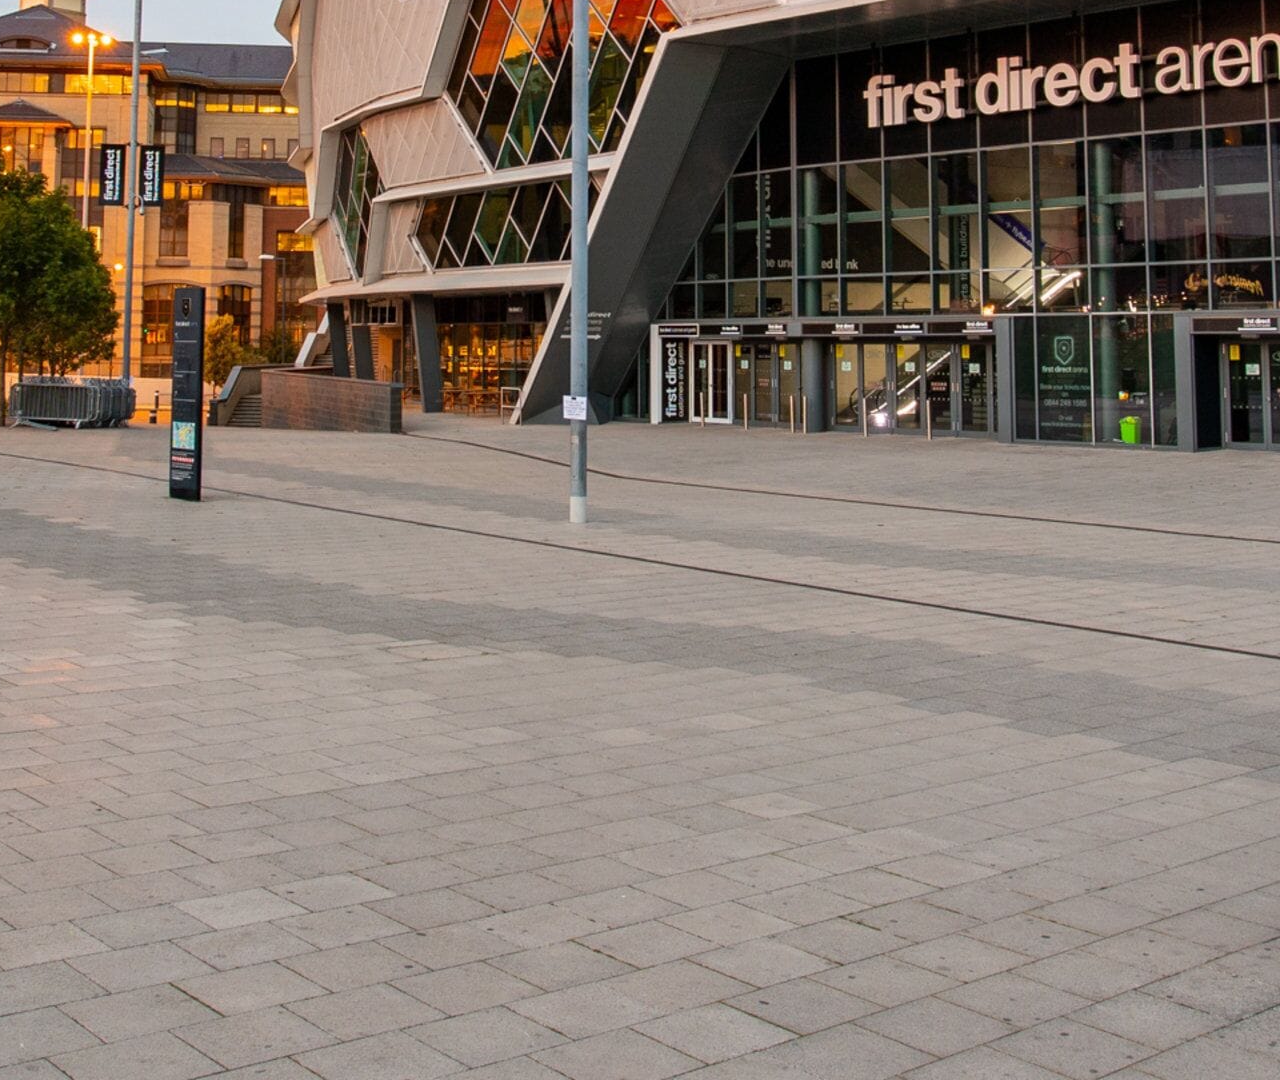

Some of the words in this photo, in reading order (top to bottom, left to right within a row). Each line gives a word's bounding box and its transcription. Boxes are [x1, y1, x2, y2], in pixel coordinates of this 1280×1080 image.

[863, 67, 966, 128] first
[975, 42, 1142, 116] direct
[104, 149, 115, 179] direct
[144, 151, 154, 180] direct
[103, 180, 114, 201] first
[143, 181, 153, 201] first
[960, 214, 968, 258] building
[665, 342, 677, 385] direct
[665, 387, 677, 418] first
